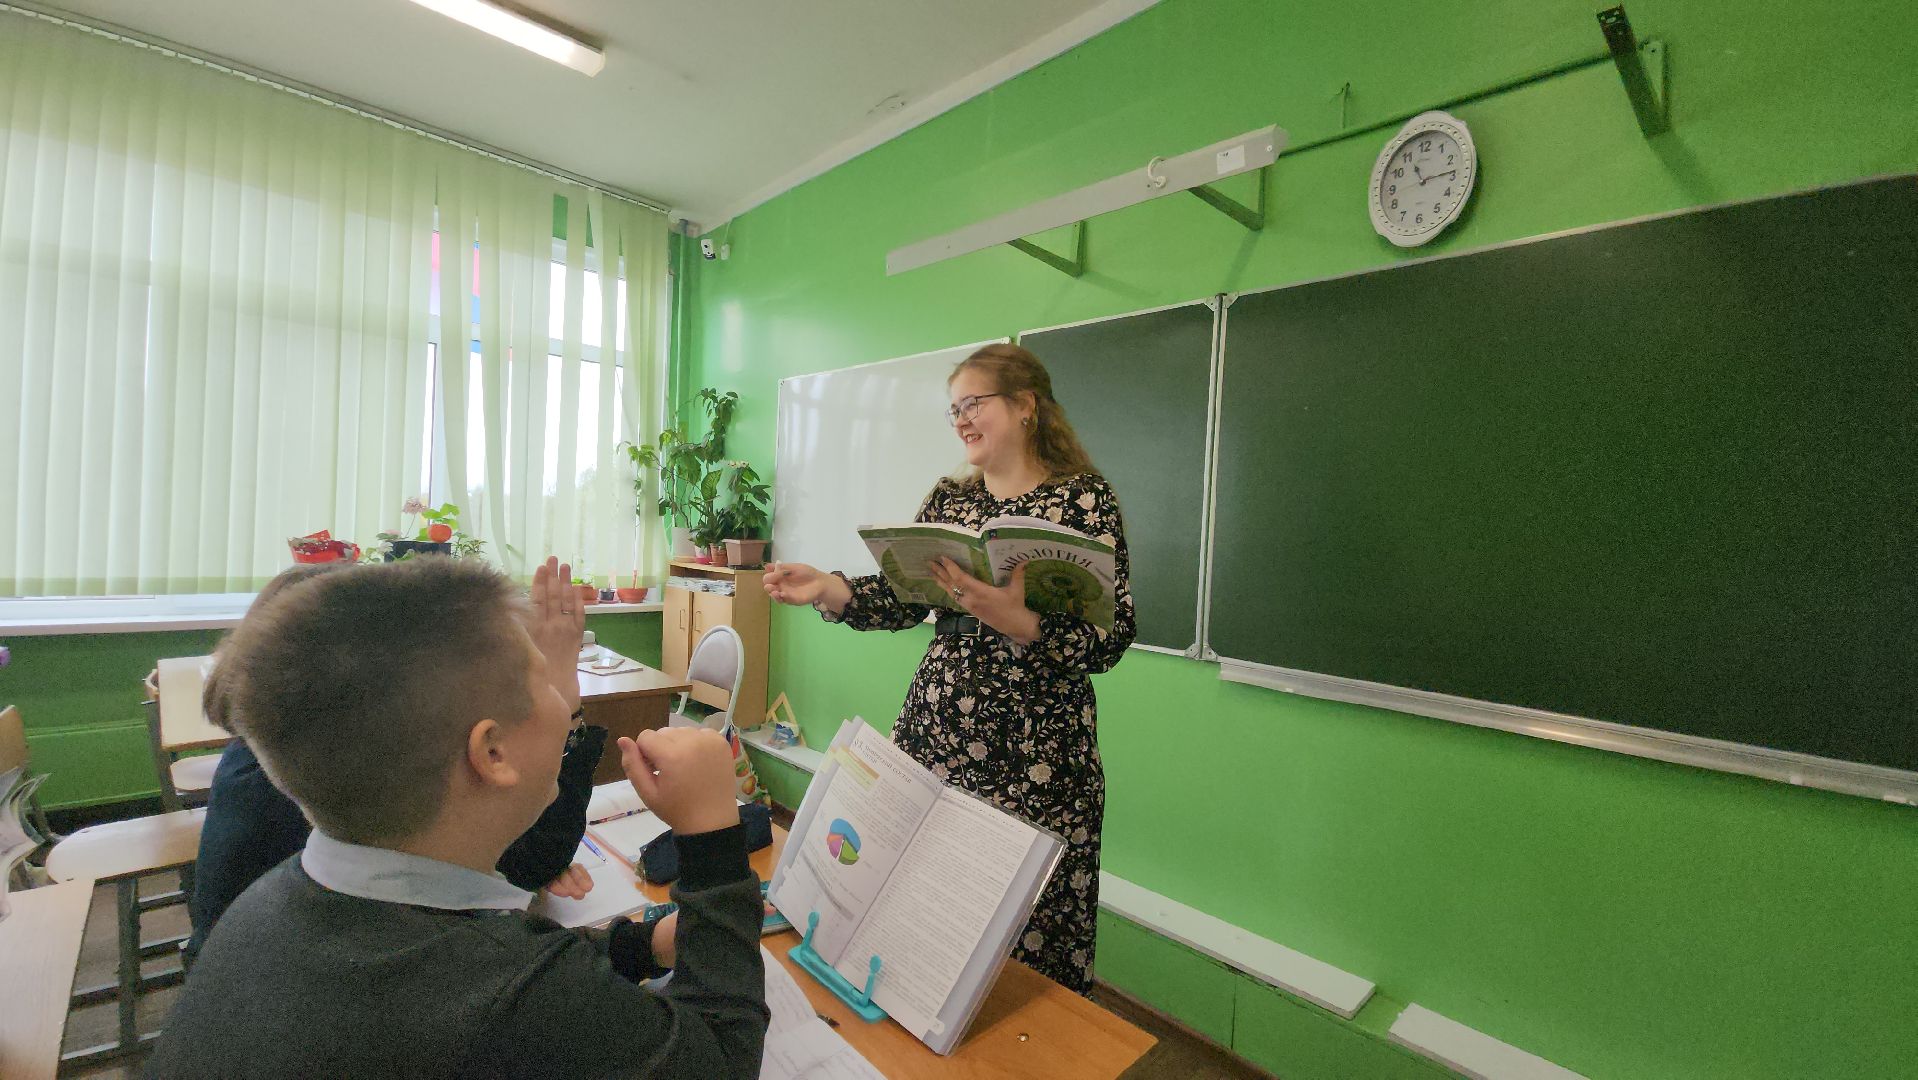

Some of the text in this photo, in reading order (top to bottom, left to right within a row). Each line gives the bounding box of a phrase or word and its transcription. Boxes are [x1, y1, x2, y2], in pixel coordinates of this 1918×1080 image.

[1418, 141, 1432, 153] 12
[1438, 144, 1445, 153] 1
[1402, 152, 1412, 163] 11
[1447, 155, 1454, 166] 2
[1391, 168, 1404, 179] 10
[1450, 170, 1457, 182] 3
[1388, 185, 1396, 196] 9
[1443, 187, 1451, 197] 4
[1391, 199, 1398, 210] 8
[1433, 203, 1441, 214] 5
[1400, 211, 1407, 222] 7
[1415, 213, 1423, 224] 6
